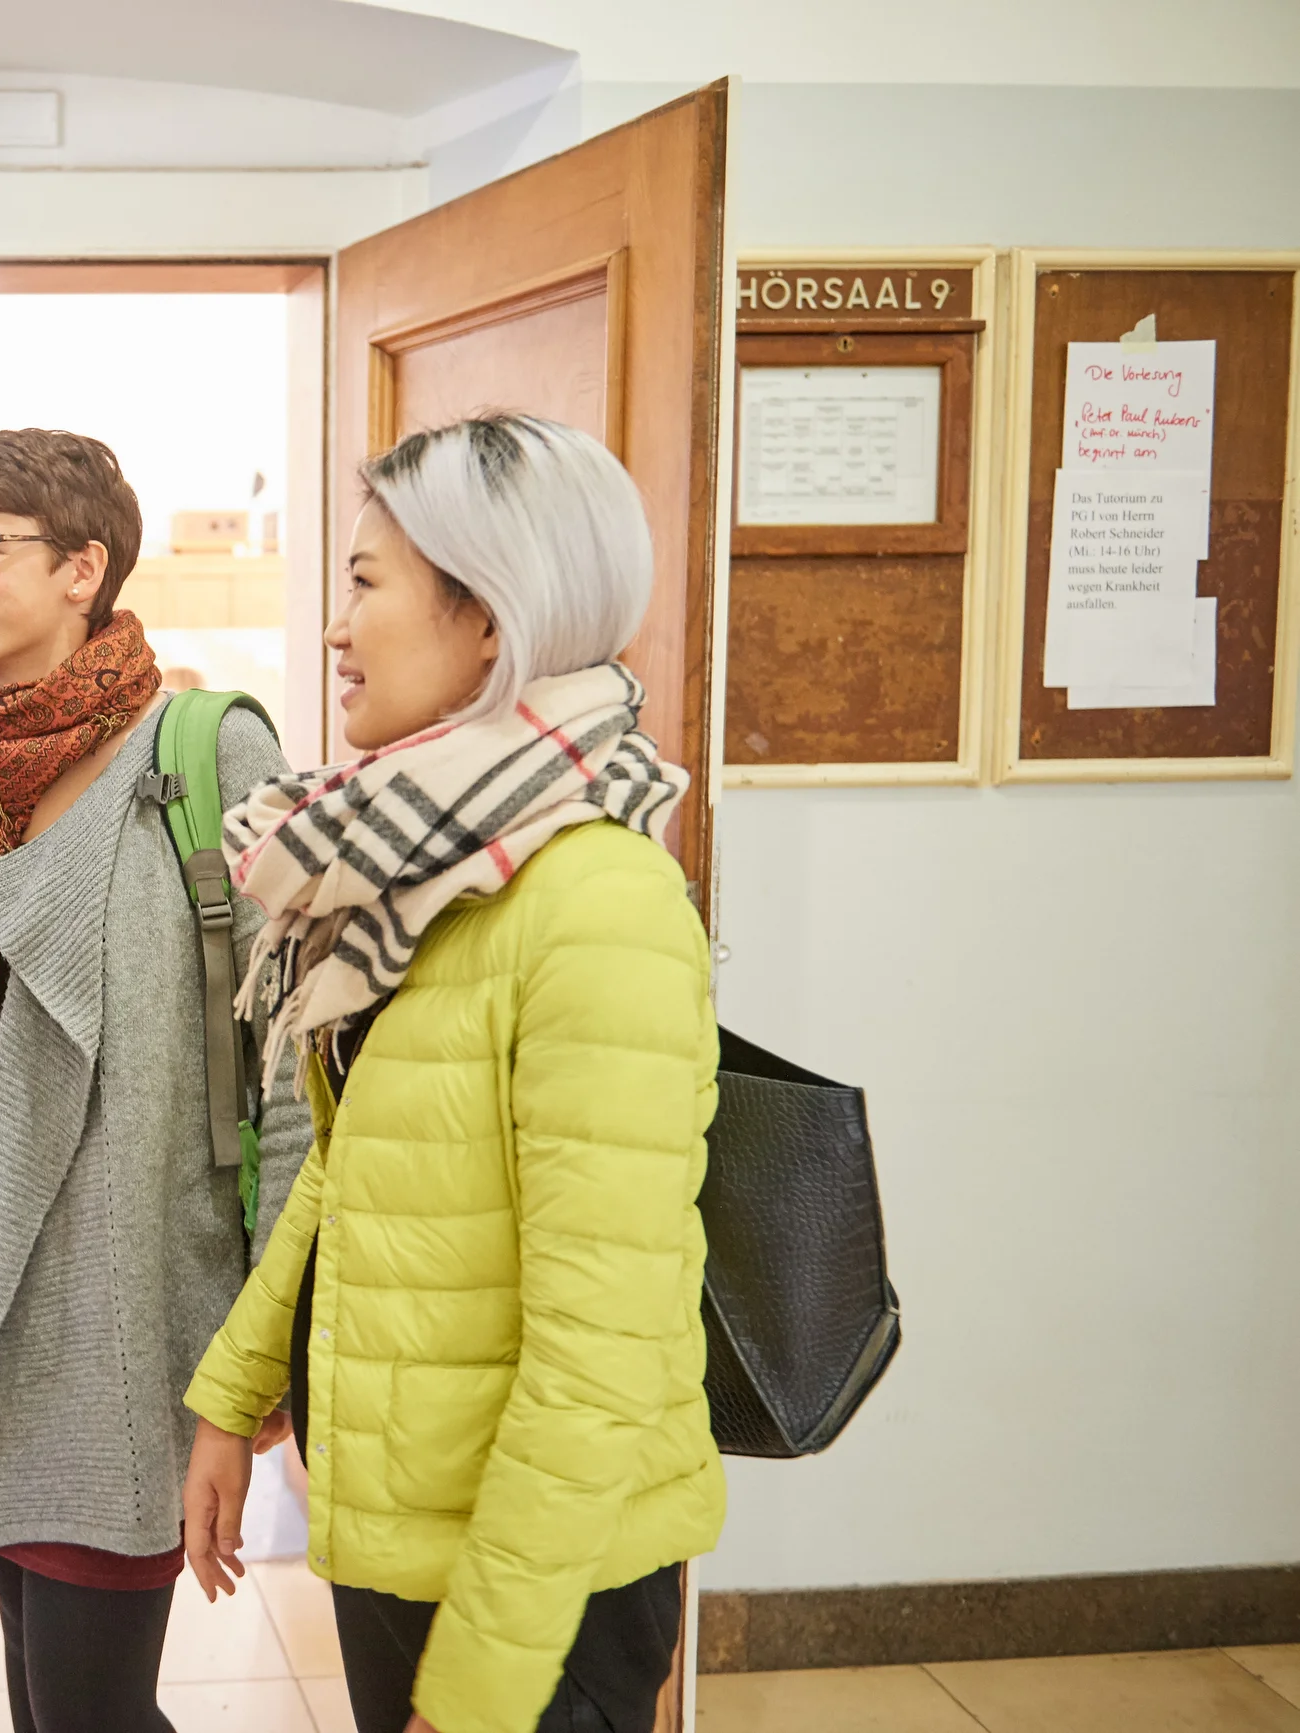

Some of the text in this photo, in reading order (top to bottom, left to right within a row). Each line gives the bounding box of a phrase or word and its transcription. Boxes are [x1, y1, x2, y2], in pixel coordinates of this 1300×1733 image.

[735, 271, 949, 309] HÖRSAAL 9
[1122, 364, 1183, 397] Vorlesung
[1121, 403, 1149, 425] Paul
[1134, 448, 1158, 459] am
[1072, 492, 1163, 504] Das Tutorium zu
[1071, 510, 1088, 521] PG
[1099, 513, 1119, 522] von
[1122, 509, 1155, 522] Herrn
[1070, 527, 1165, 540] Robert Schneider
[1099, 545, 1131, 557] 14-16
[1134, 545, 1161, 557] Uhr)
[1068, 562, 1163, 575] muss heute leider
[1067, 580, 1160, 595] wegen Krankheit
[1066, 598, 1117, 610] ausfallen.
